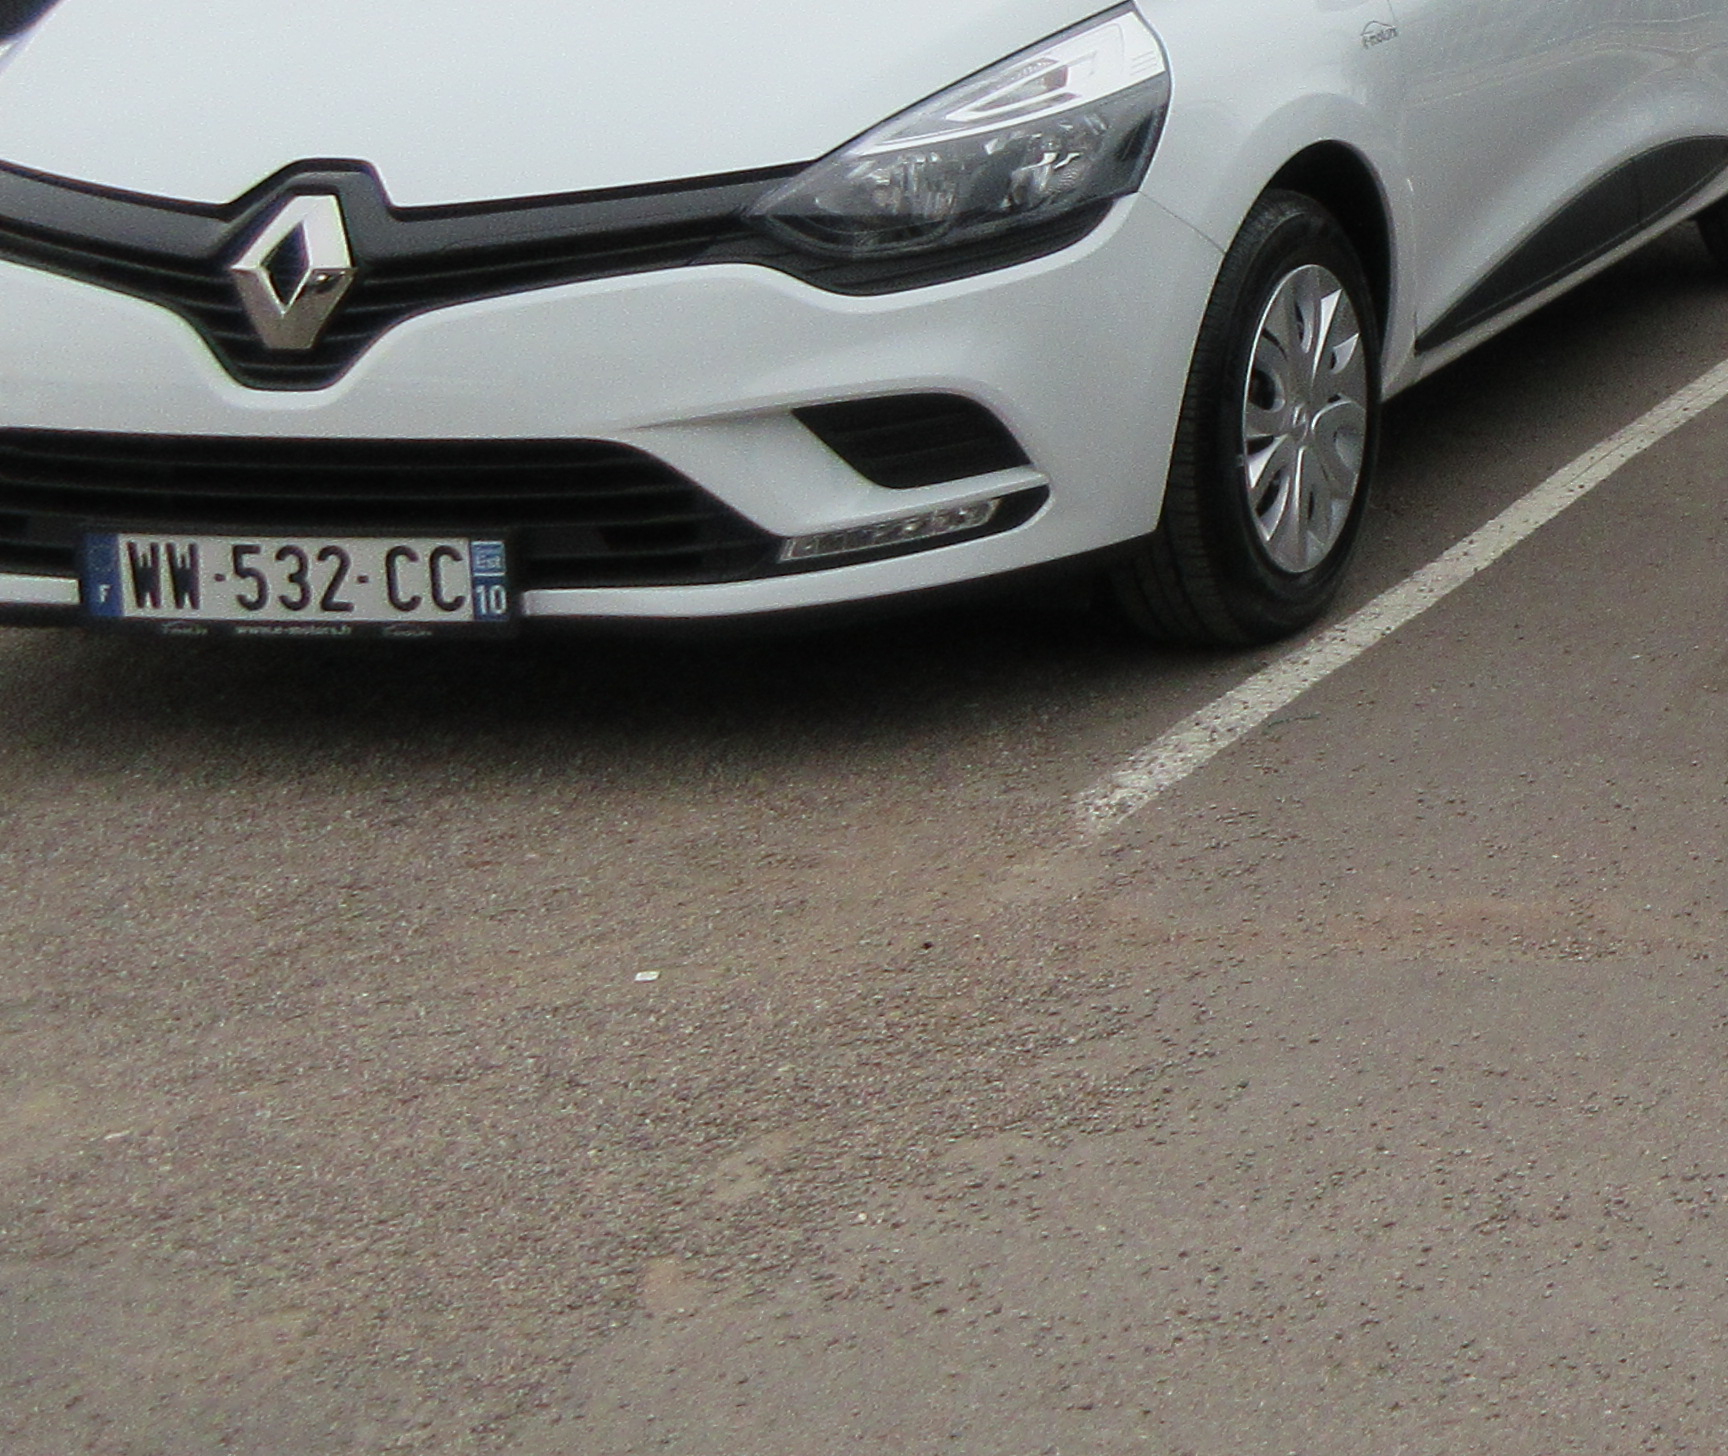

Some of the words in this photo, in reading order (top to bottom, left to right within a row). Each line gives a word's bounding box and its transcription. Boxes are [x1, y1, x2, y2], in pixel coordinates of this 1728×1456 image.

[99, 584, 110, 604] F
[127, 541, 467, 614] WW-532-CC
[475, 584, 507, 615] 10
